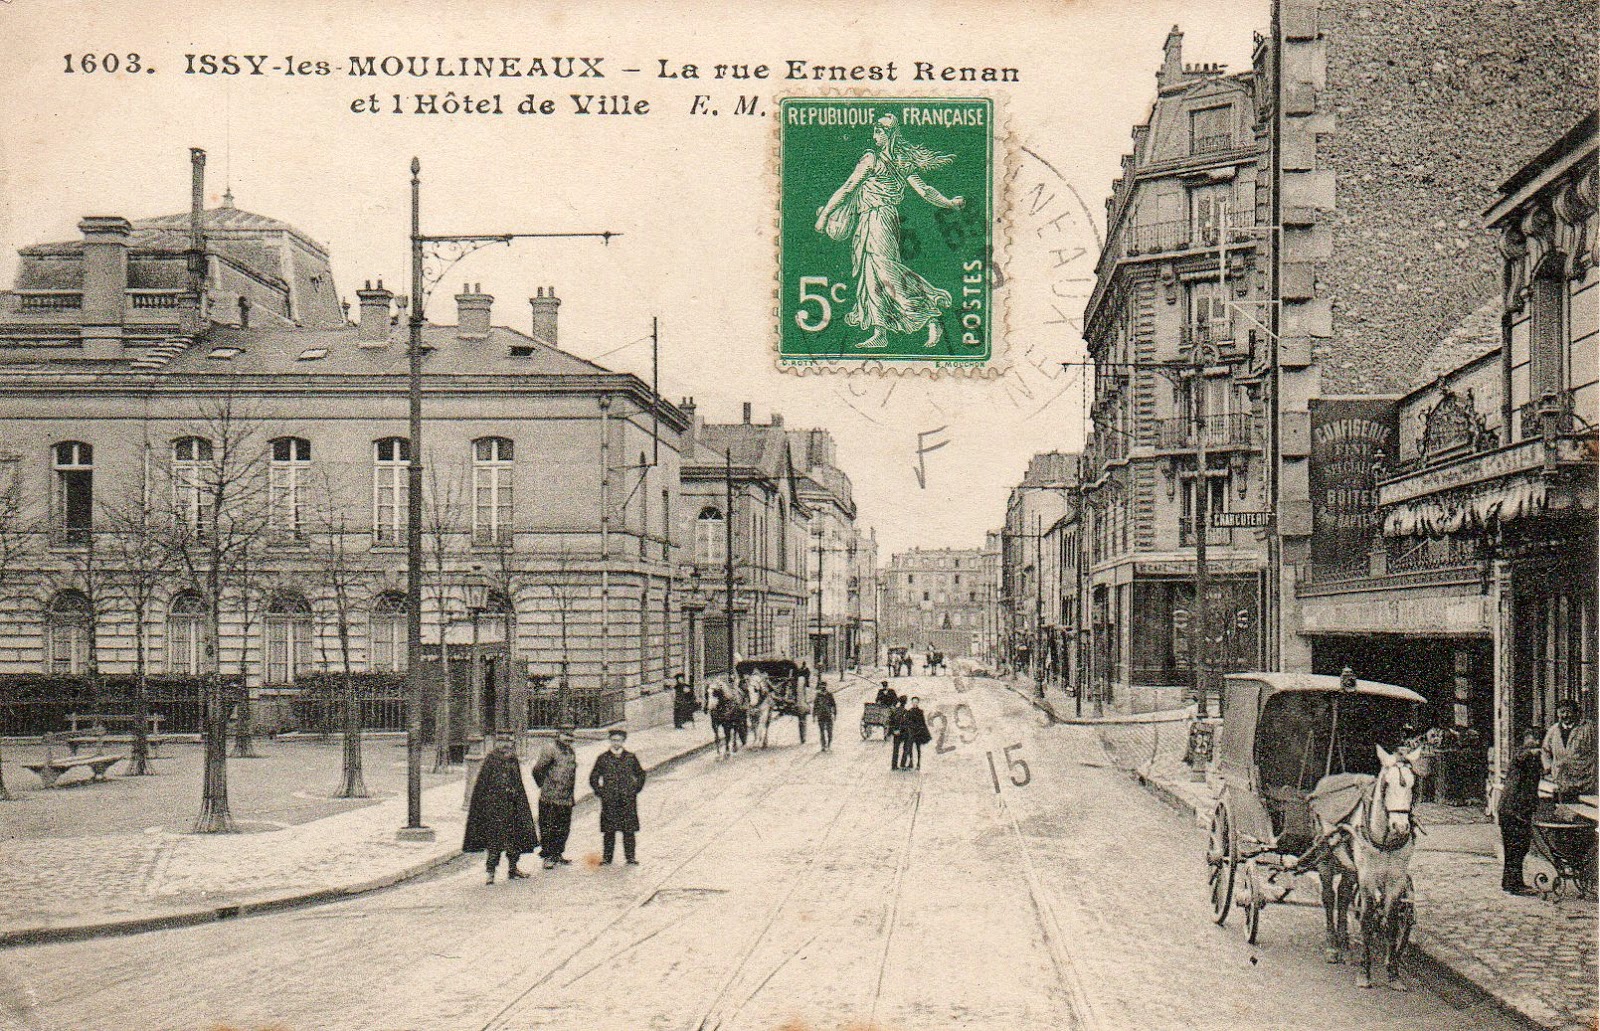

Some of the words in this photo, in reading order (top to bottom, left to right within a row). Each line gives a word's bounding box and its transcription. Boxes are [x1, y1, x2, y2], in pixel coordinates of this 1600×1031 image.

[902, 107, 984, 129] FRANÇAISE
[962, 259, 982, 345] POSTES
[986, 742, 1031, 794] 15
